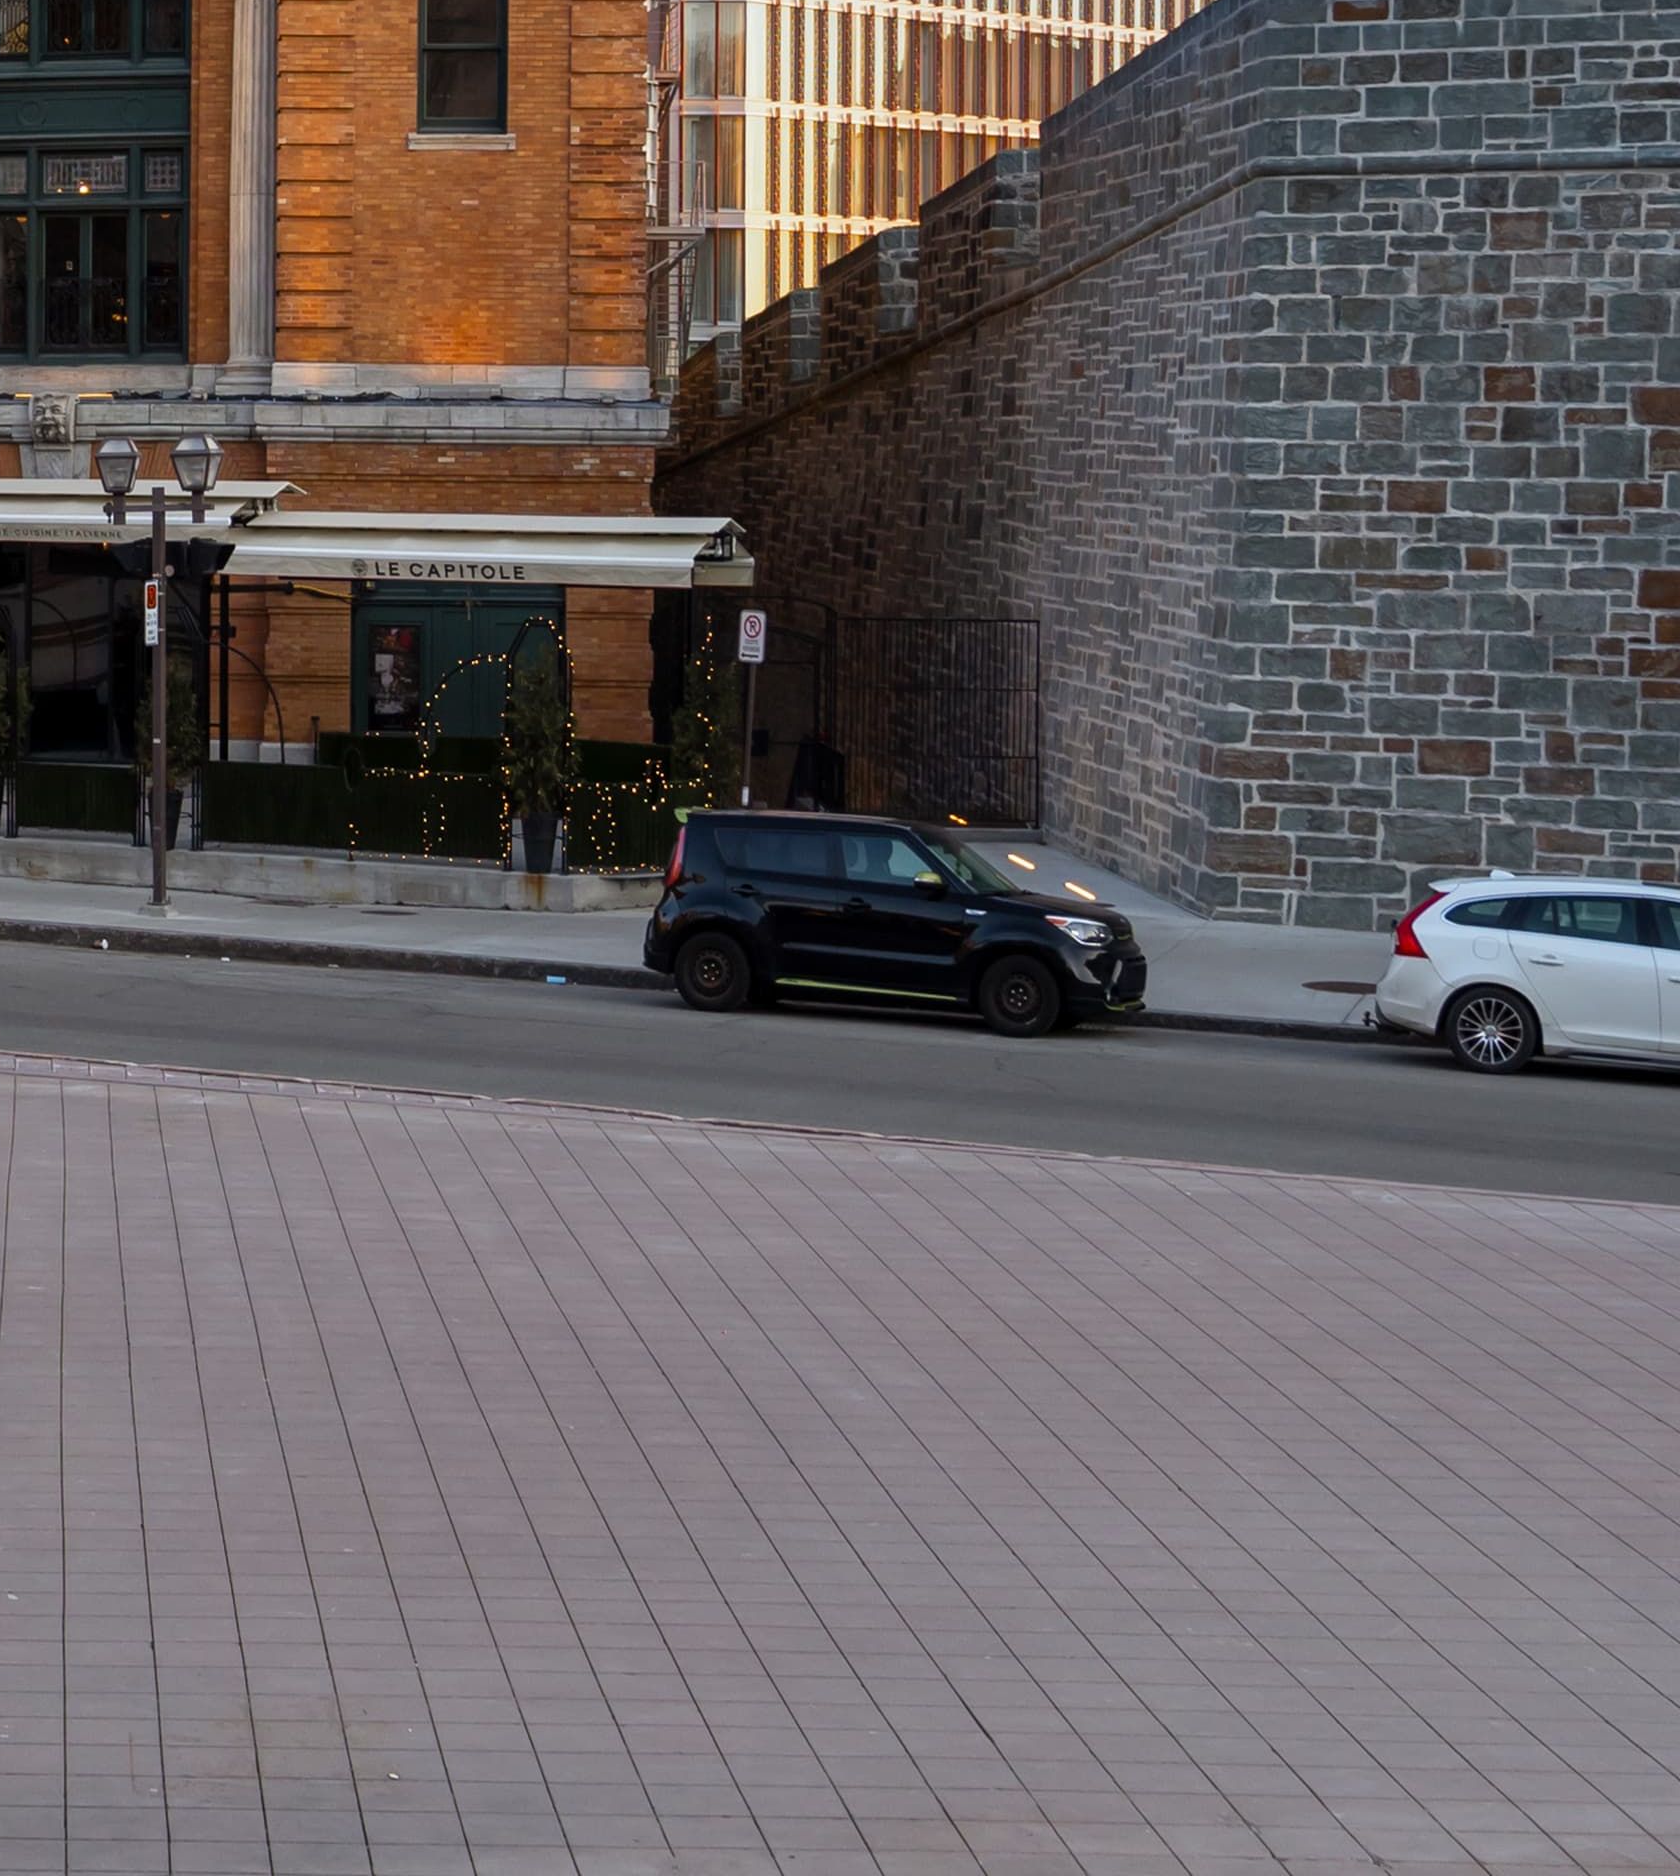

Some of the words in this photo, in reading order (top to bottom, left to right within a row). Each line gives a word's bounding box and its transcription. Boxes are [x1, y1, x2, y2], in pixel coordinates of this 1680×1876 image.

[15, 528, 59, 538] CUISINE
[65, 529, 122, 540] ITALIENNE
[375, 561, 400, 577] LE
[409, 562, 526, 580] CAPITOLE
